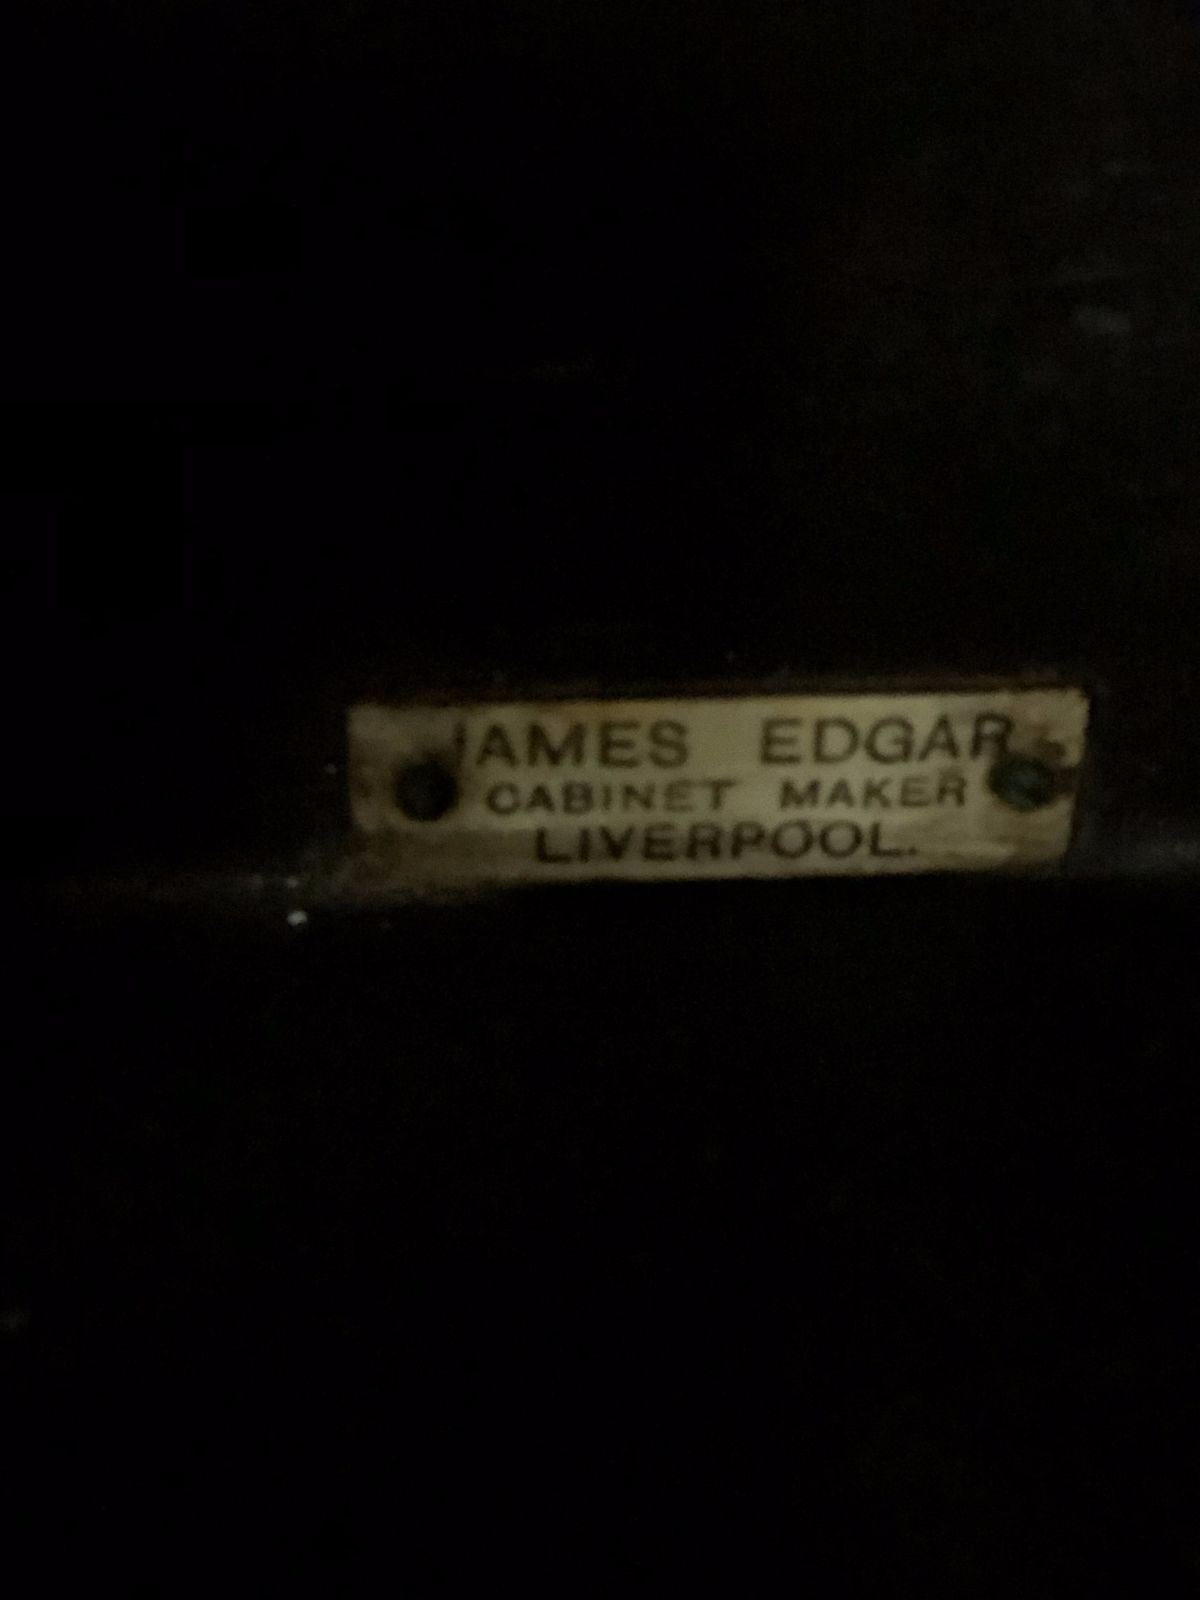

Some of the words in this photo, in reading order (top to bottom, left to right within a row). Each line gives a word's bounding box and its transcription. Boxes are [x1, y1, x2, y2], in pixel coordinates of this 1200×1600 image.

[760, 712, 1014, 764] EDGAR
[485, 777, 738, 816] CABINET
[779, 767, 967, 808] MAKER
[534, 819, 917, 864] LIVERPOOL.
